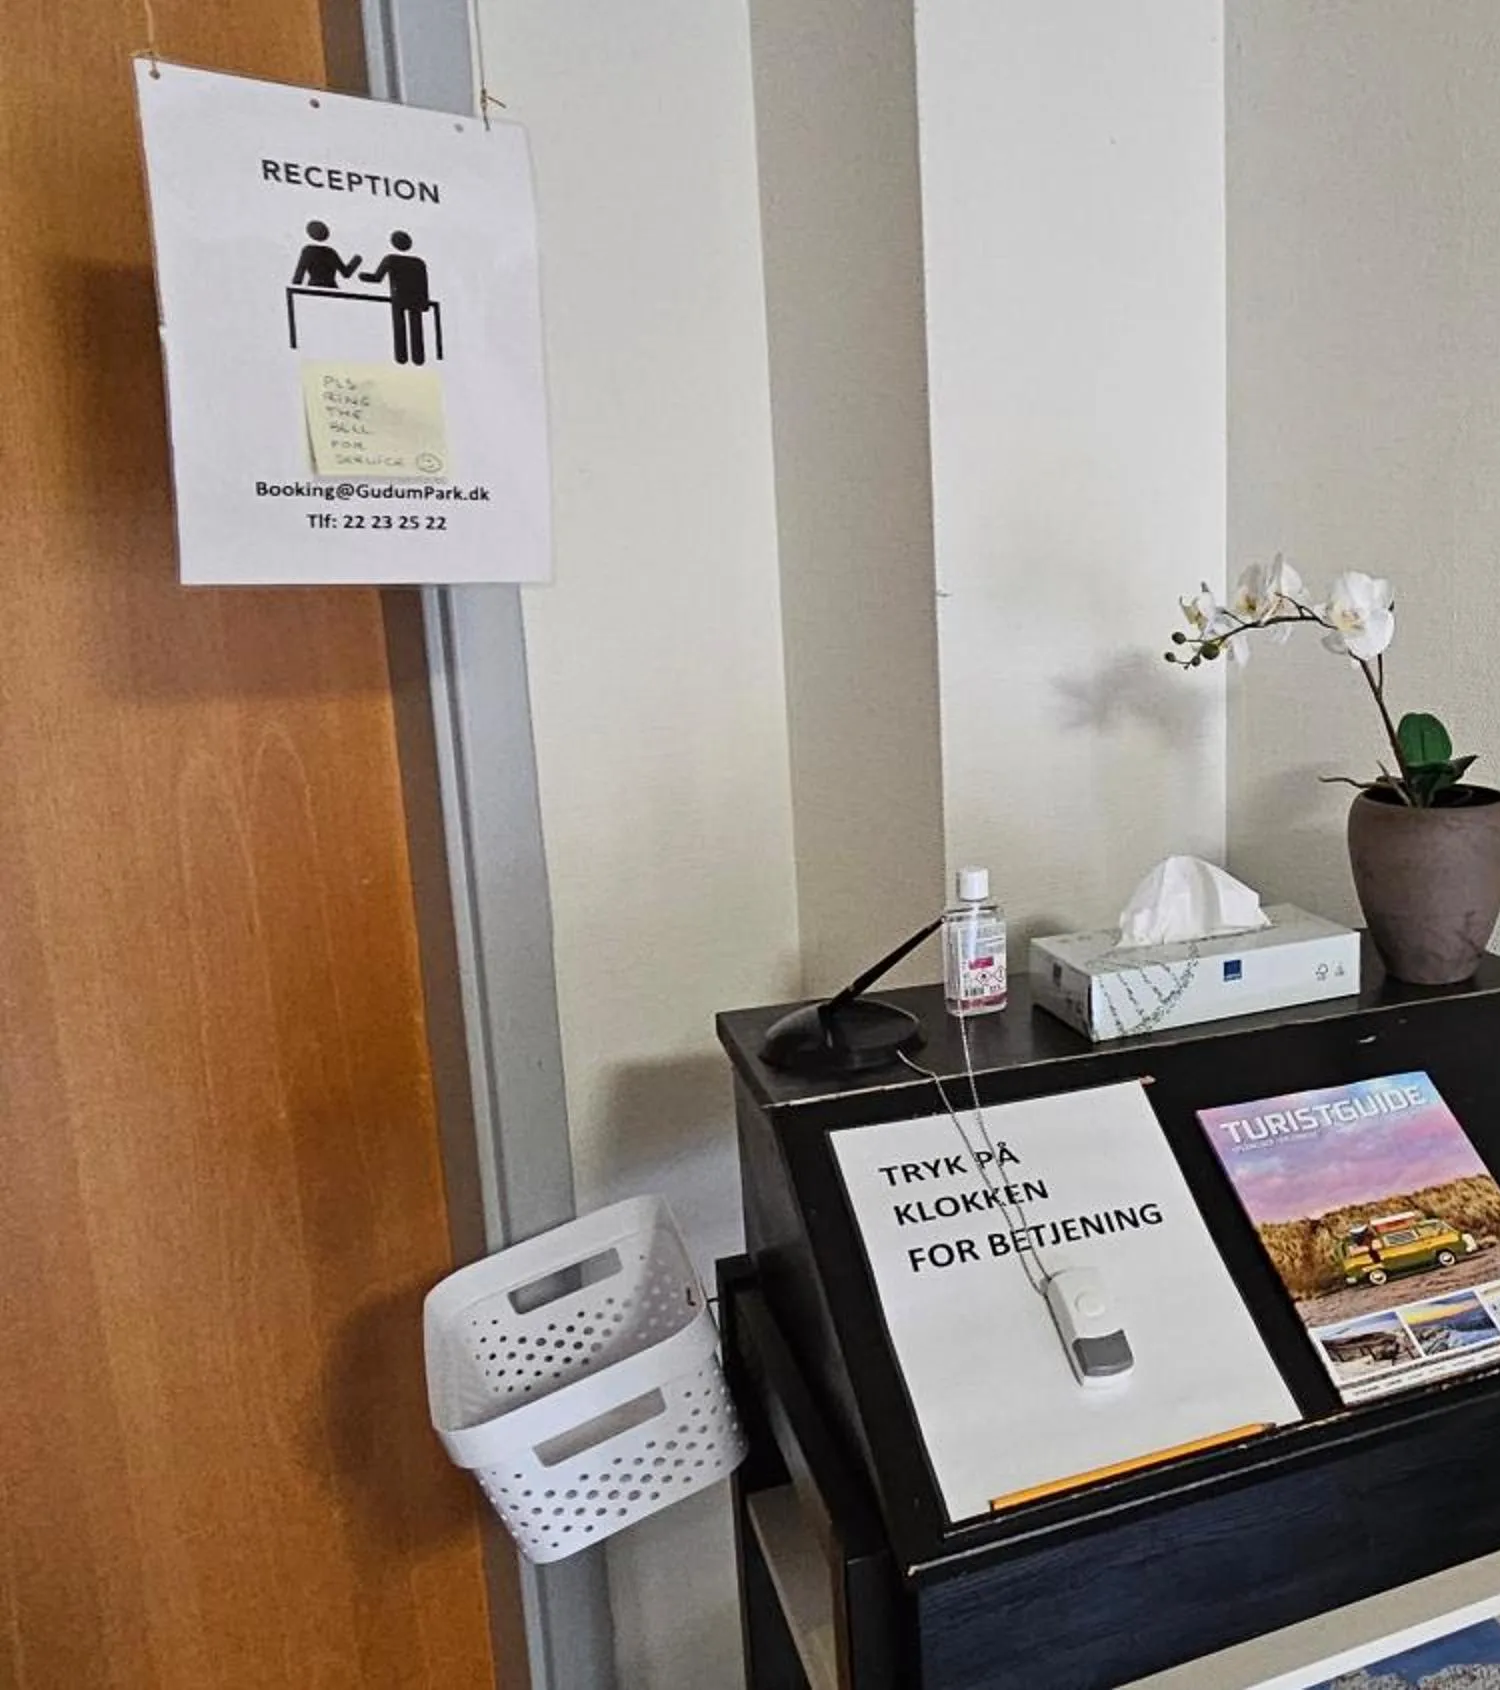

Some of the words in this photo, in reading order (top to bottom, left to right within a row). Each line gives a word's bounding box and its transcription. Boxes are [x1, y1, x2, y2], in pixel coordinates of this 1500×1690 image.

[261, 159, 440, 204] RECEPTION
[255, 481, 491, 502] Booking@GudumPark.dk
[306, 513, 338, 530] Tlf:
[343, 514, 365, 530] 22
[371, 515, 393, 530] 23
[399, 515, 420, 531] 25
[425, 515, 447, 531] 22
[1220, 1084, 1426, 1144] TURISTGUIDE
[878, 1155, 968, 1187] TRYK
[973, 1141, 1021, 1170] PÅ
[893, 1179, 1050, 1226] KLOKKEN
[907, 1238, 981, 1273] FOR
[987, 1203, 1164, 1257] BETJENING
